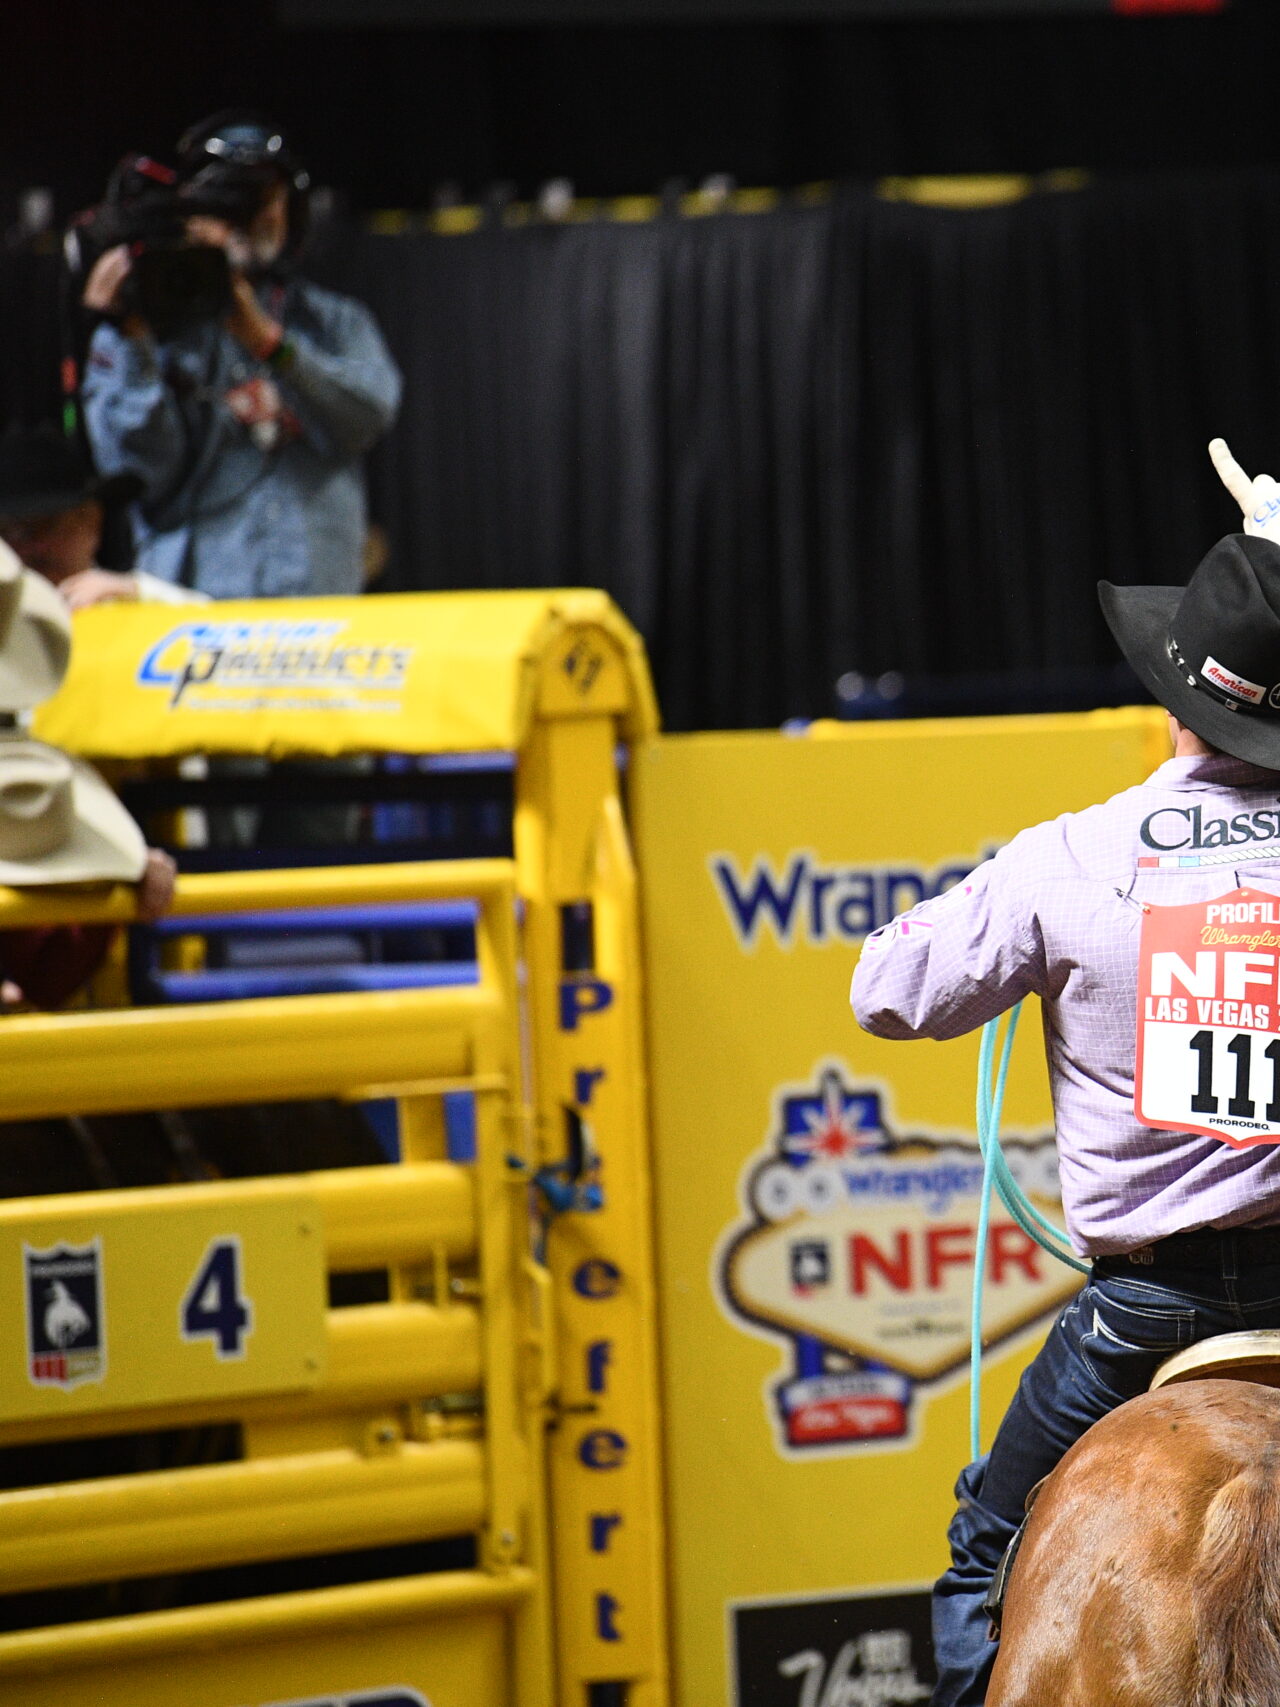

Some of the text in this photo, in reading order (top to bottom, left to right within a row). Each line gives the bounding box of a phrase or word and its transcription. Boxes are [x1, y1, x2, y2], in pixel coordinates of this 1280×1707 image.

[1207, 666, 1259, 698] American
[716, 848, 998, 942] Wran
[1144, 996, 1188, 1022] LAS
[1196, 999, 1270, 1030] VEGAS
[182, 1243, 250, 1355] 4
[847, 1220, 1044, 1297] NFR
[557, 975, 630, 1643] Prefert
